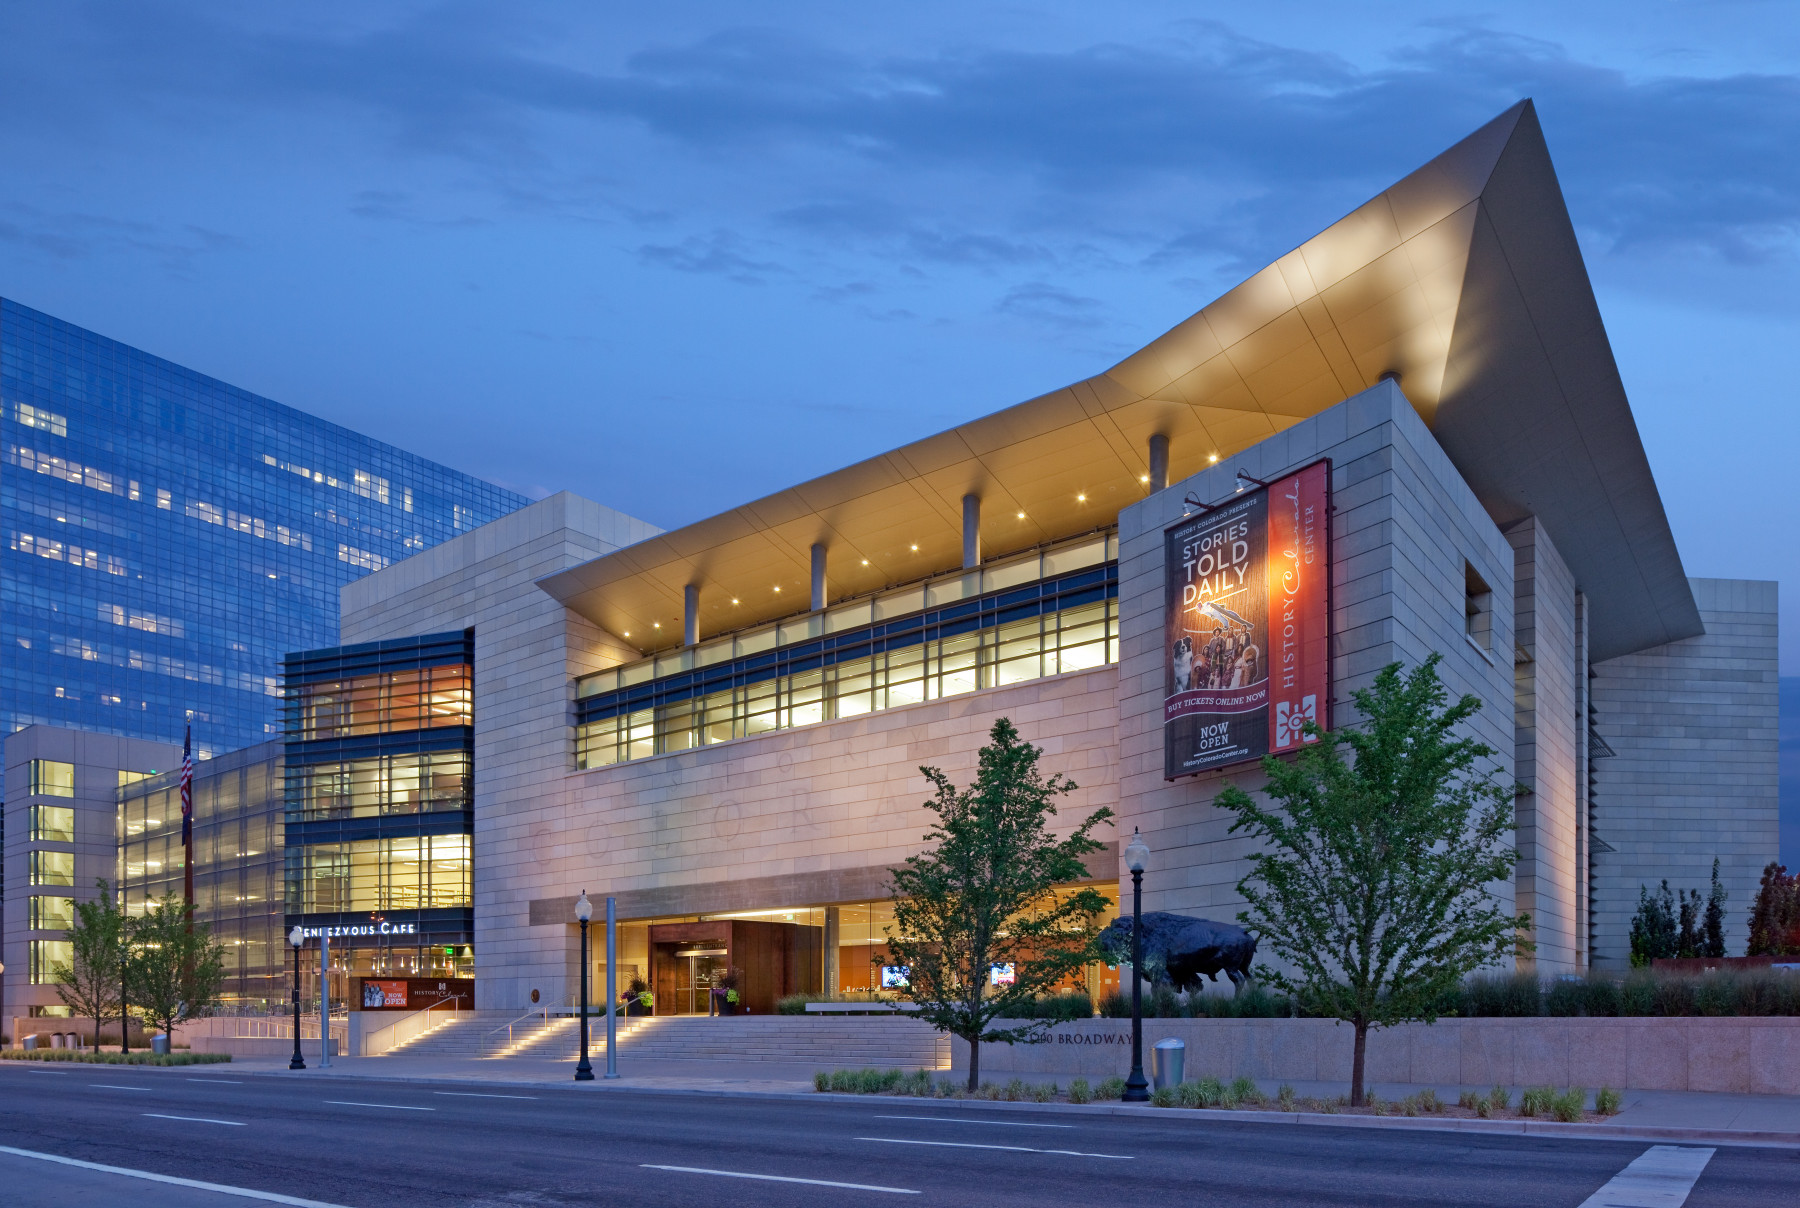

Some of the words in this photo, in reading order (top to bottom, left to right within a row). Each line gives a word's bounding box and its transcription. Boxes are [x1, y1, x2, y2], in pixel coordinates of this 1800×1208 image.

[1174, 525, 1196, 539] HISTORY
[1197, 512, 1228, 528] COLORADO
[1228, 499, 1257, 515] PRESENTS
[1282, 478, 1300, 595] Colorado
[1304, 504, 1314, 564] CENTER
[1183, 521, 1248, 560] STORIES
[1183, 540, 1248, 582] TOLD
[1183, 562, 1249, 606] DAILY
[1283, 598, 1294, 688] HISTORY
[1167, 701, 1183, 713] BUY
[1184, 697, 1214, 707] TICKETS
[1215, 696, 1244, 706] ONLINE
[1246, 689, 1266, 704] NOW
[1200, 722, 1229, 739] NOW
[1200, 734, 1229, 750] OPEN
[531, 739, 1110, 867] COLORAO
[380, 922, 415, 934] CAFE
[1058, 1033, 1134, 1045] BROADWAY
